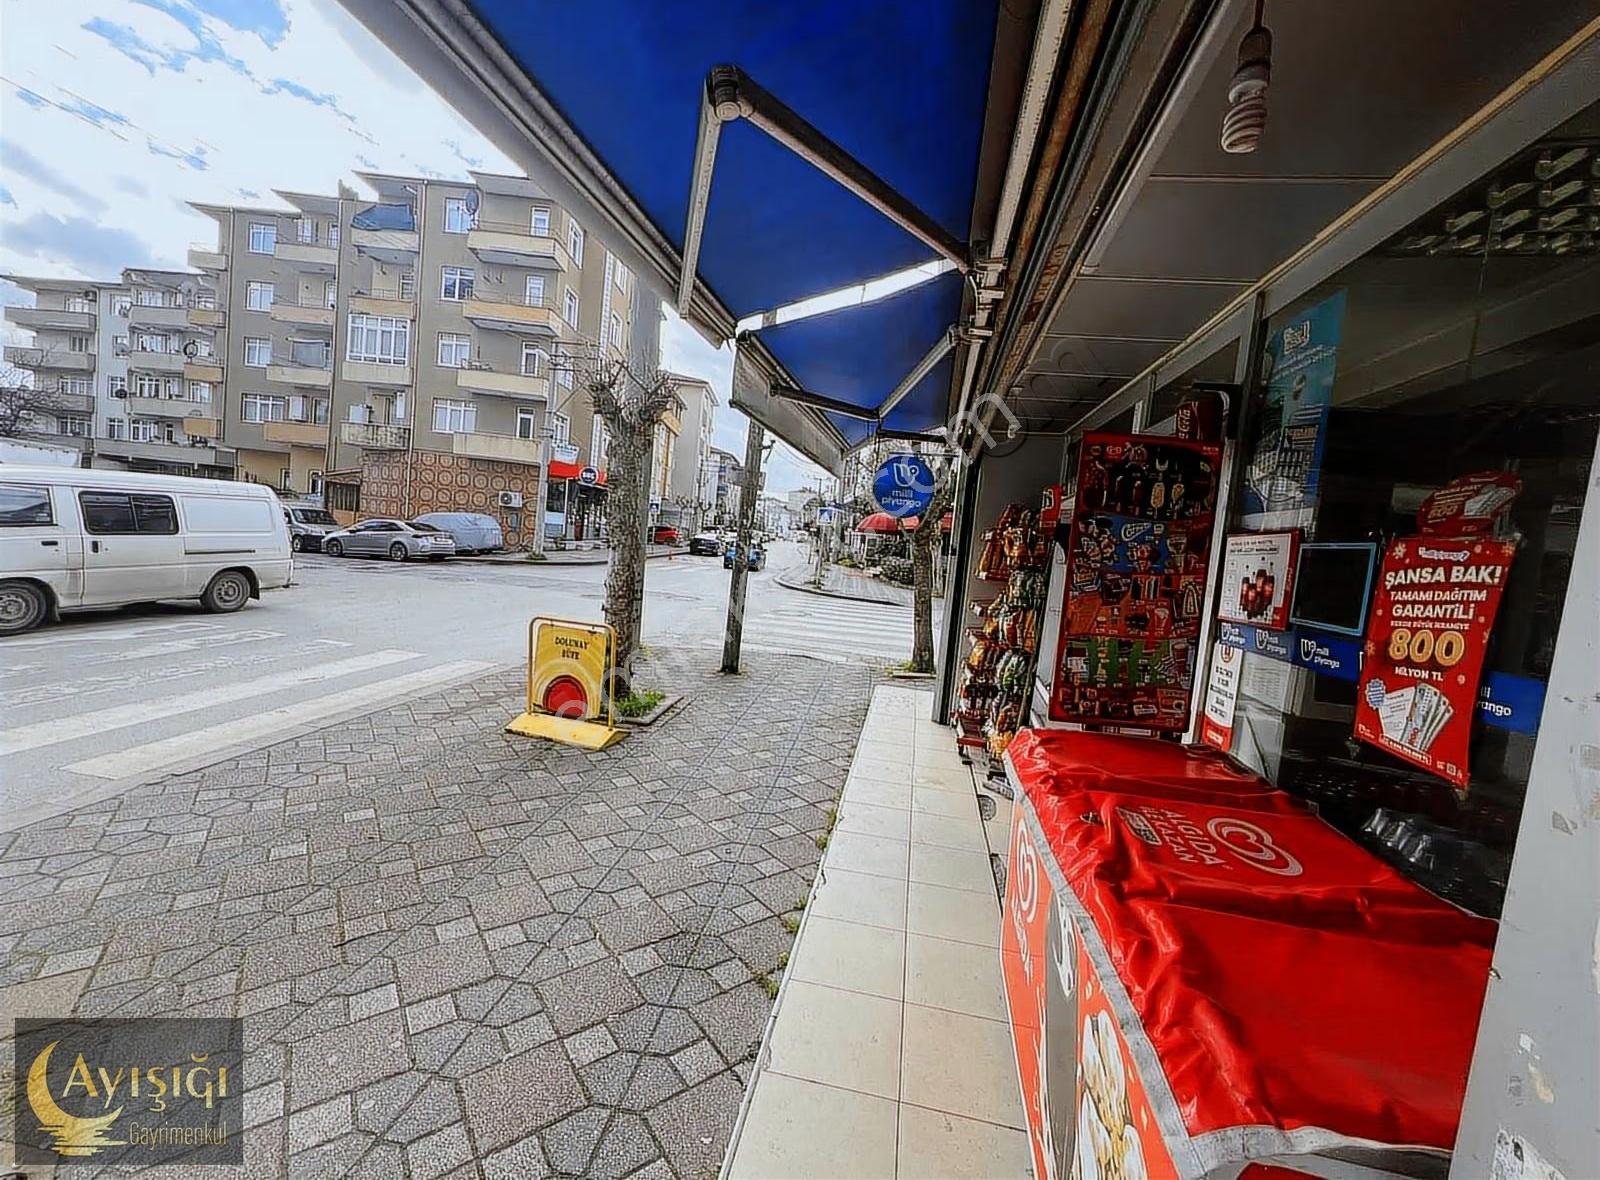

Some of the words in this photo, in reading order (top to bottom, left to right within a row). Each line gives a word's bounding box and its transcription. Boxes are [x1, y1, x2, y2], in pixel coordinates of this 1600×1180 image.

[891, 488, 914, 498] milli
[881, 496, 922, 508] piyango
[1385, 566, 1446, 590] ŞANSA
[1450, 566, 1502, 584] BAK!
[1390, 590, 1433, 601] TAMAMI
[1434, 588, 1487, 601] DAĞITIM
[1392, 603, 1476, 619] GARANTİLİ
[555, 636, 588, 650] DOLUNAY
[1389, 628, 1465, 666] 800
[562, 648, 580, 660] BÜFE
[1431, 671, 1444, 681] TL
[1160, 807, 1228, 865] ALGIDA
